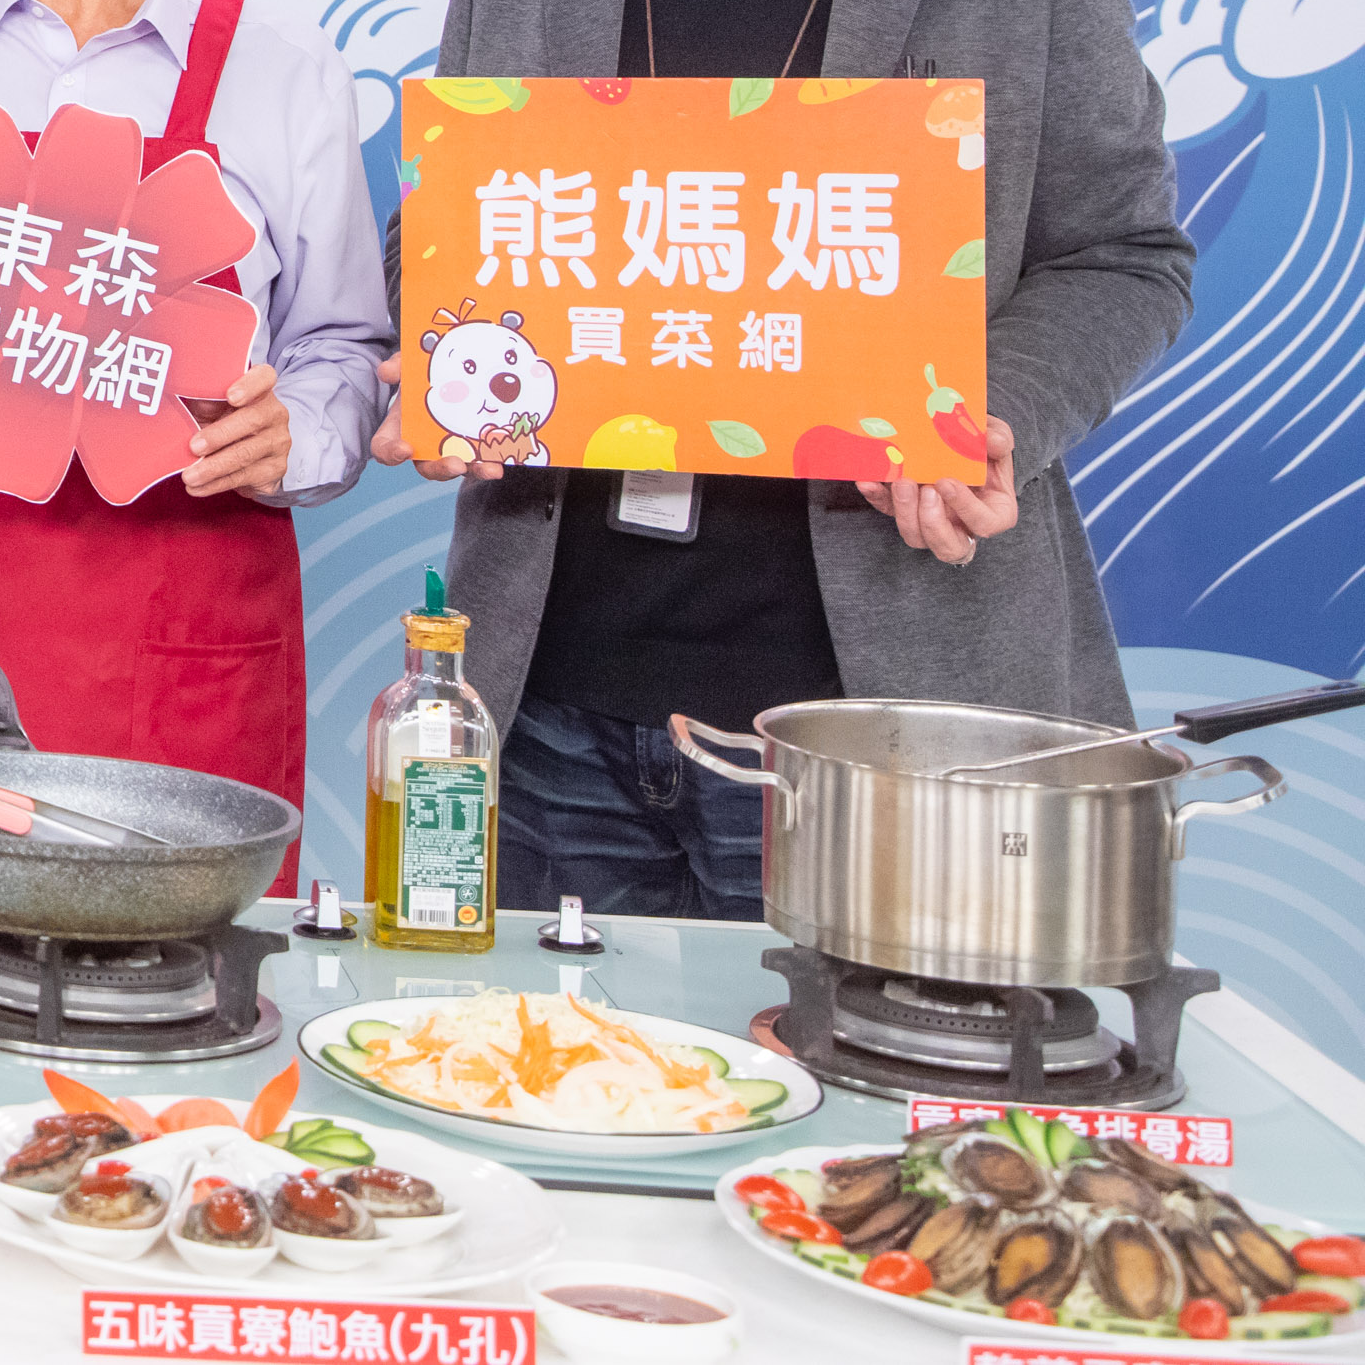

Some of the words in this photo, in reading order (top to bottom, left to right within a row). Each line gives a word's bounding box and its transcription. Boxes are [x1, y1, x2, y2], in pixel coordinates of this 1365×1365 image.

[475, 168, 900, 296] 熊媽媽
[565, 306, 803, 372] 買菜網
[87, 1299, 528, 1365] 五味貢寮鮑魚(九孔)
